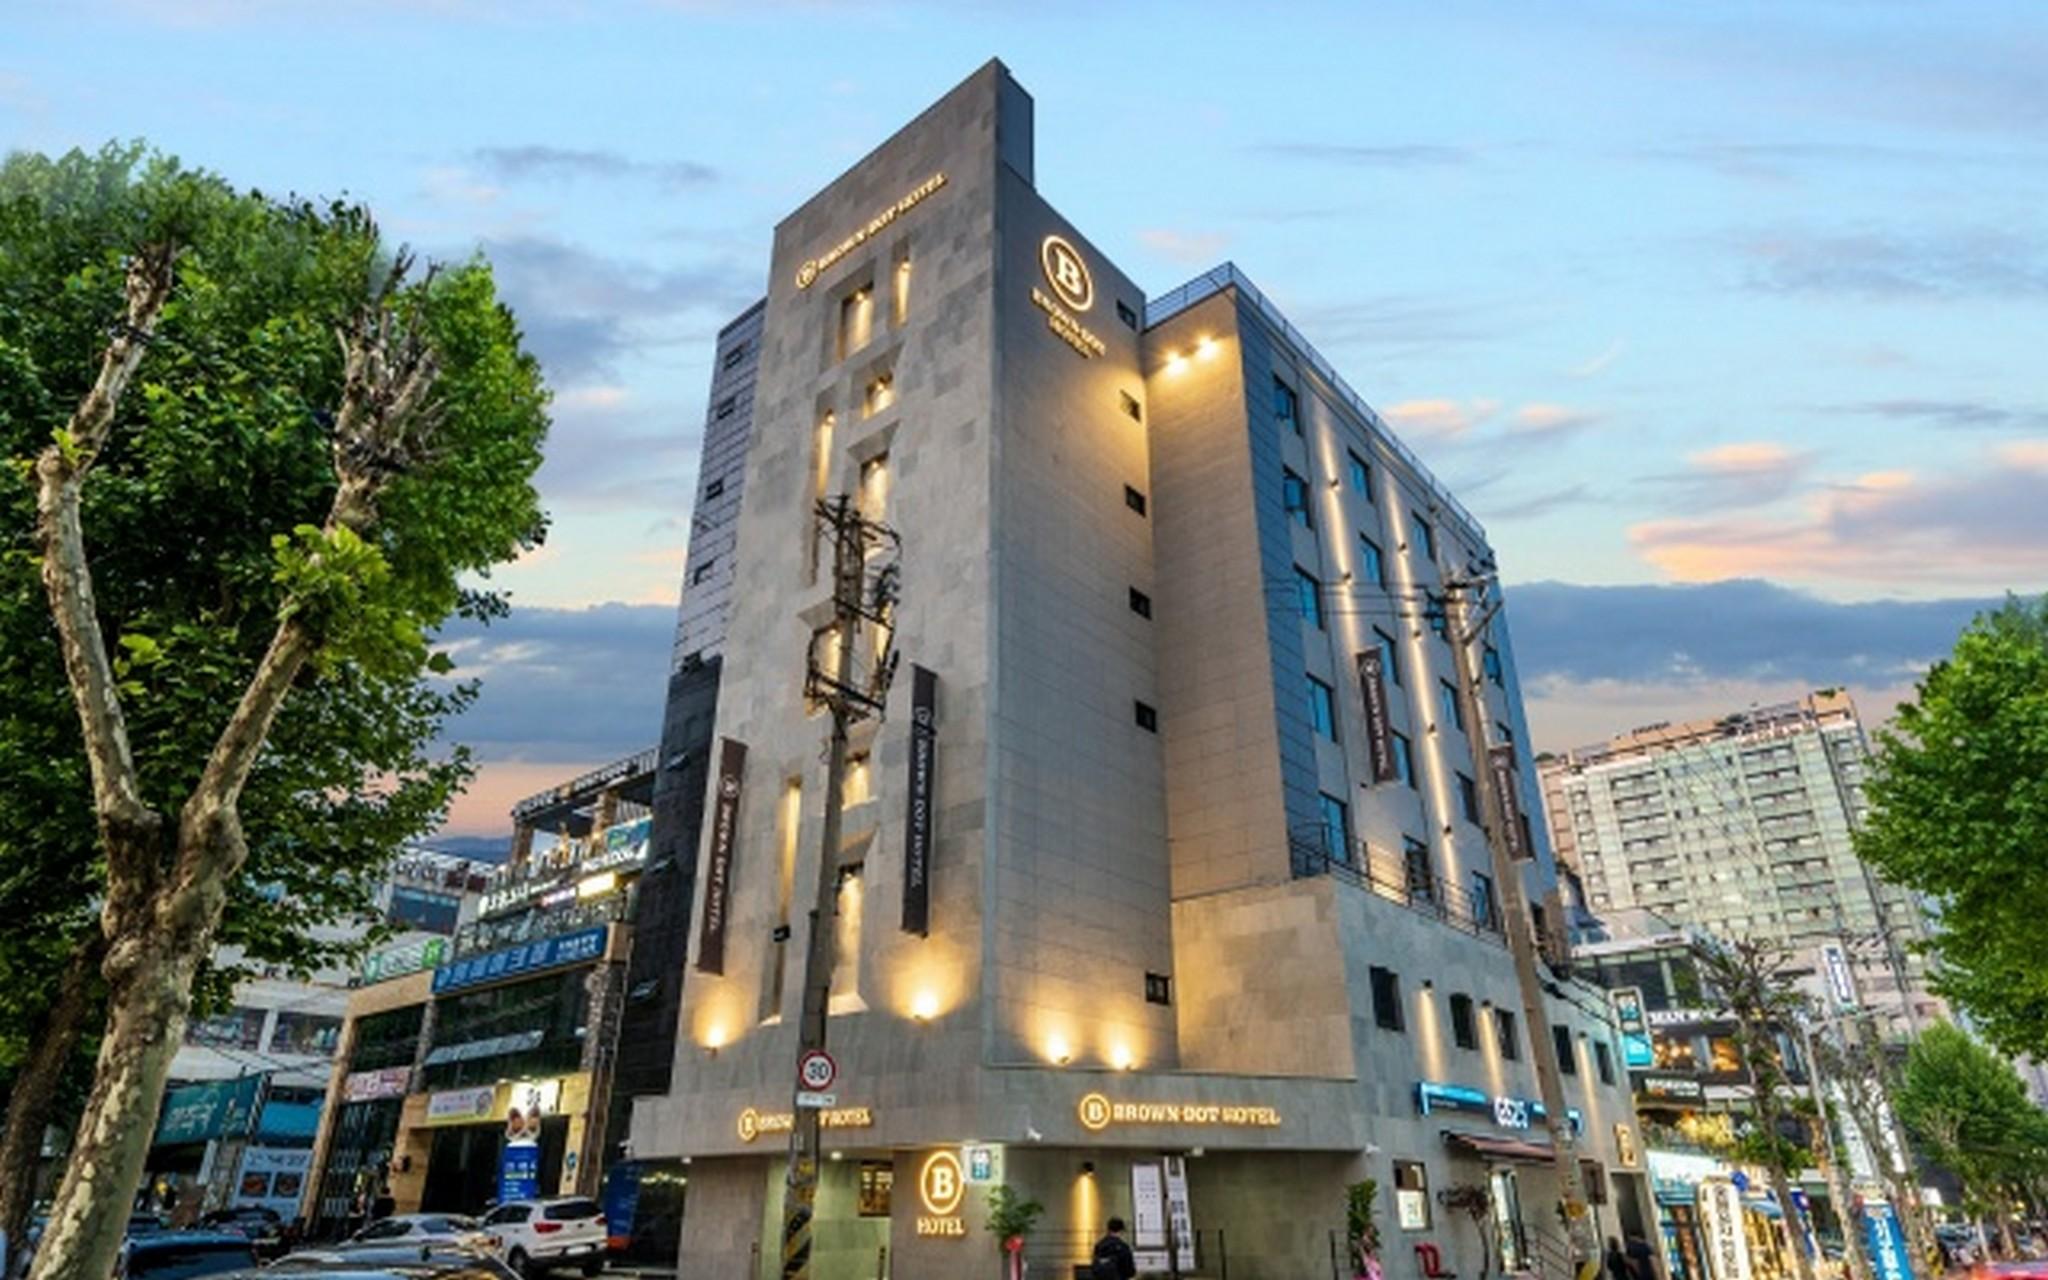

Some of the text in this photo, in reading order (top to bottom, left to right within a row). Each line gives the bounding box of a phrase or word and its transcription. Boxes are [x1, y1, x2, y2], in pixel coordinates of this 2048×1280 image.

[808, 1062, 829, 1080] 30
[1114, 1104, 1180, 1122] BROWN
[1183, 1107, 1219, 1122] DOT
[1221, 1106, 1281, 1125] HOTEL
[917, 1217, 965, 1237] HOTEL
